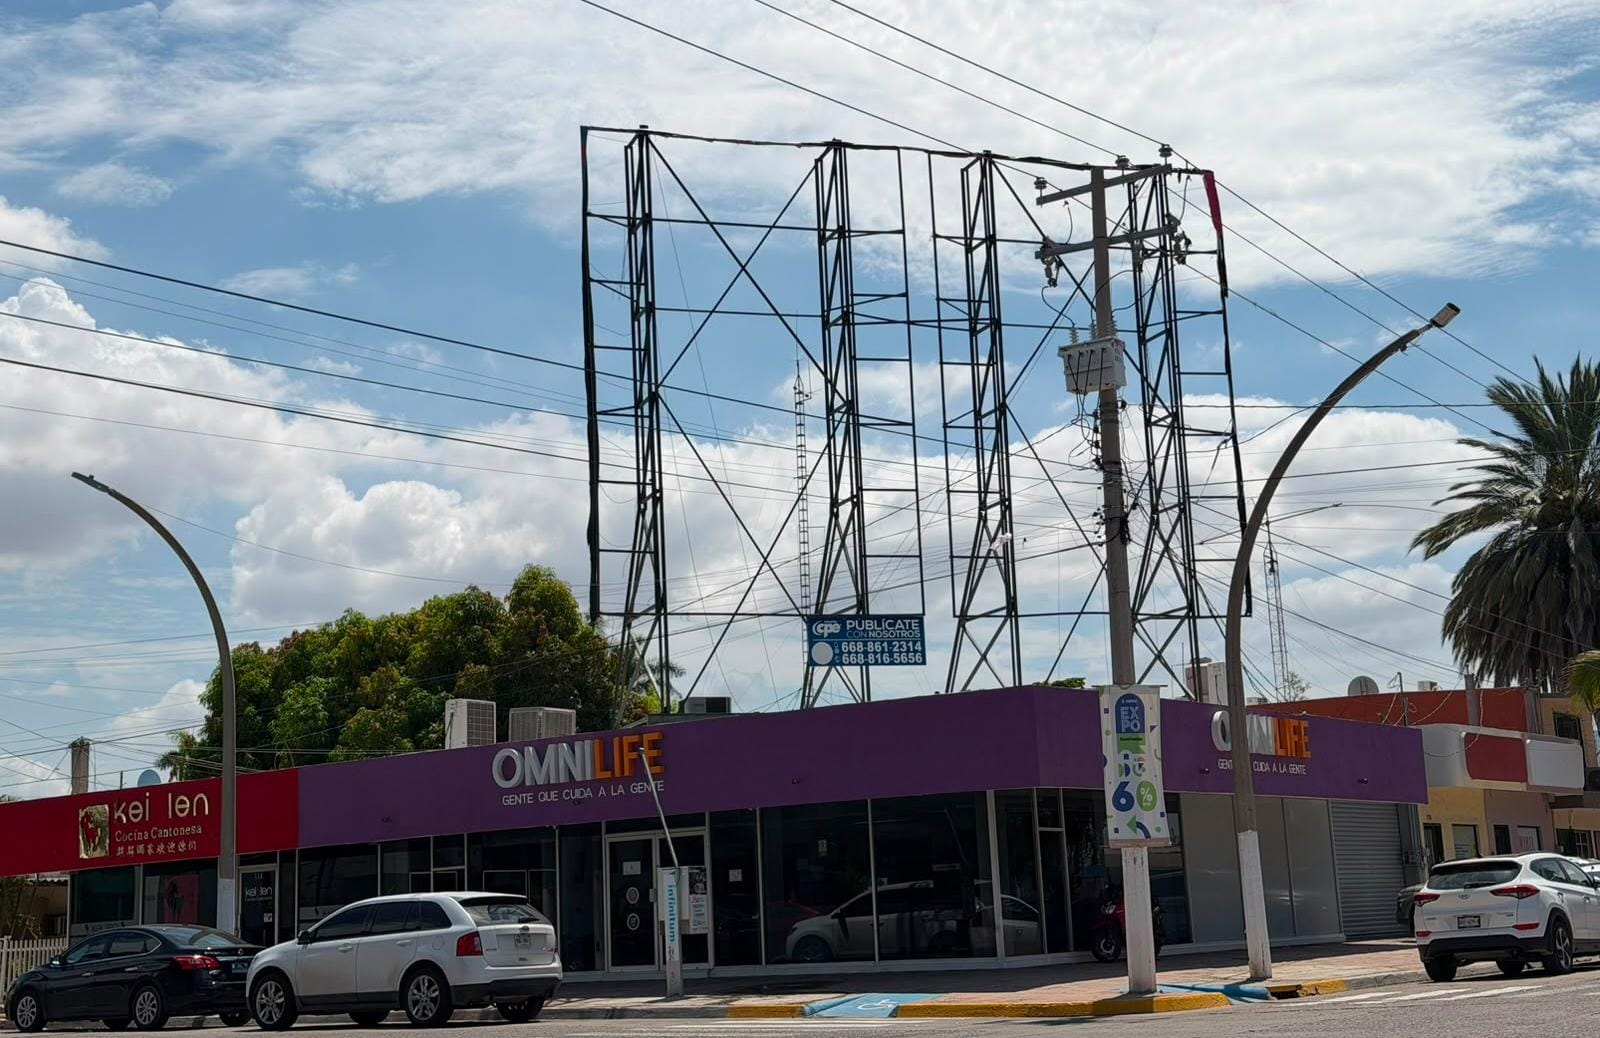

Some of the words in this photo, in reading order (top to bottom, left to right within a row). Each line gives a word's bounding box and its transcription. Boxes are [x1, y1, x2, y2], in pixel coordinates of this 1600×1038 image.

[846, 630, 868, 638] CON
[868, 630, 921, 638] NOSOTROS
[492, 731, 665, 788] OMNILIFE
[1288, 764, 1307, 775] GENTE
[502, 792, 534, 806] GENTE
[538, 790, 558, 802] QUE
[562, 786, 593, 800] CUIDA
[598, 785, 606, 797] A
[610, 784, 625, 796] LA
[630, 780, 665, 794] GENTE
[115, 829, 149, 842] Cocina
[150, 825, 202, 839] Cantonesa
